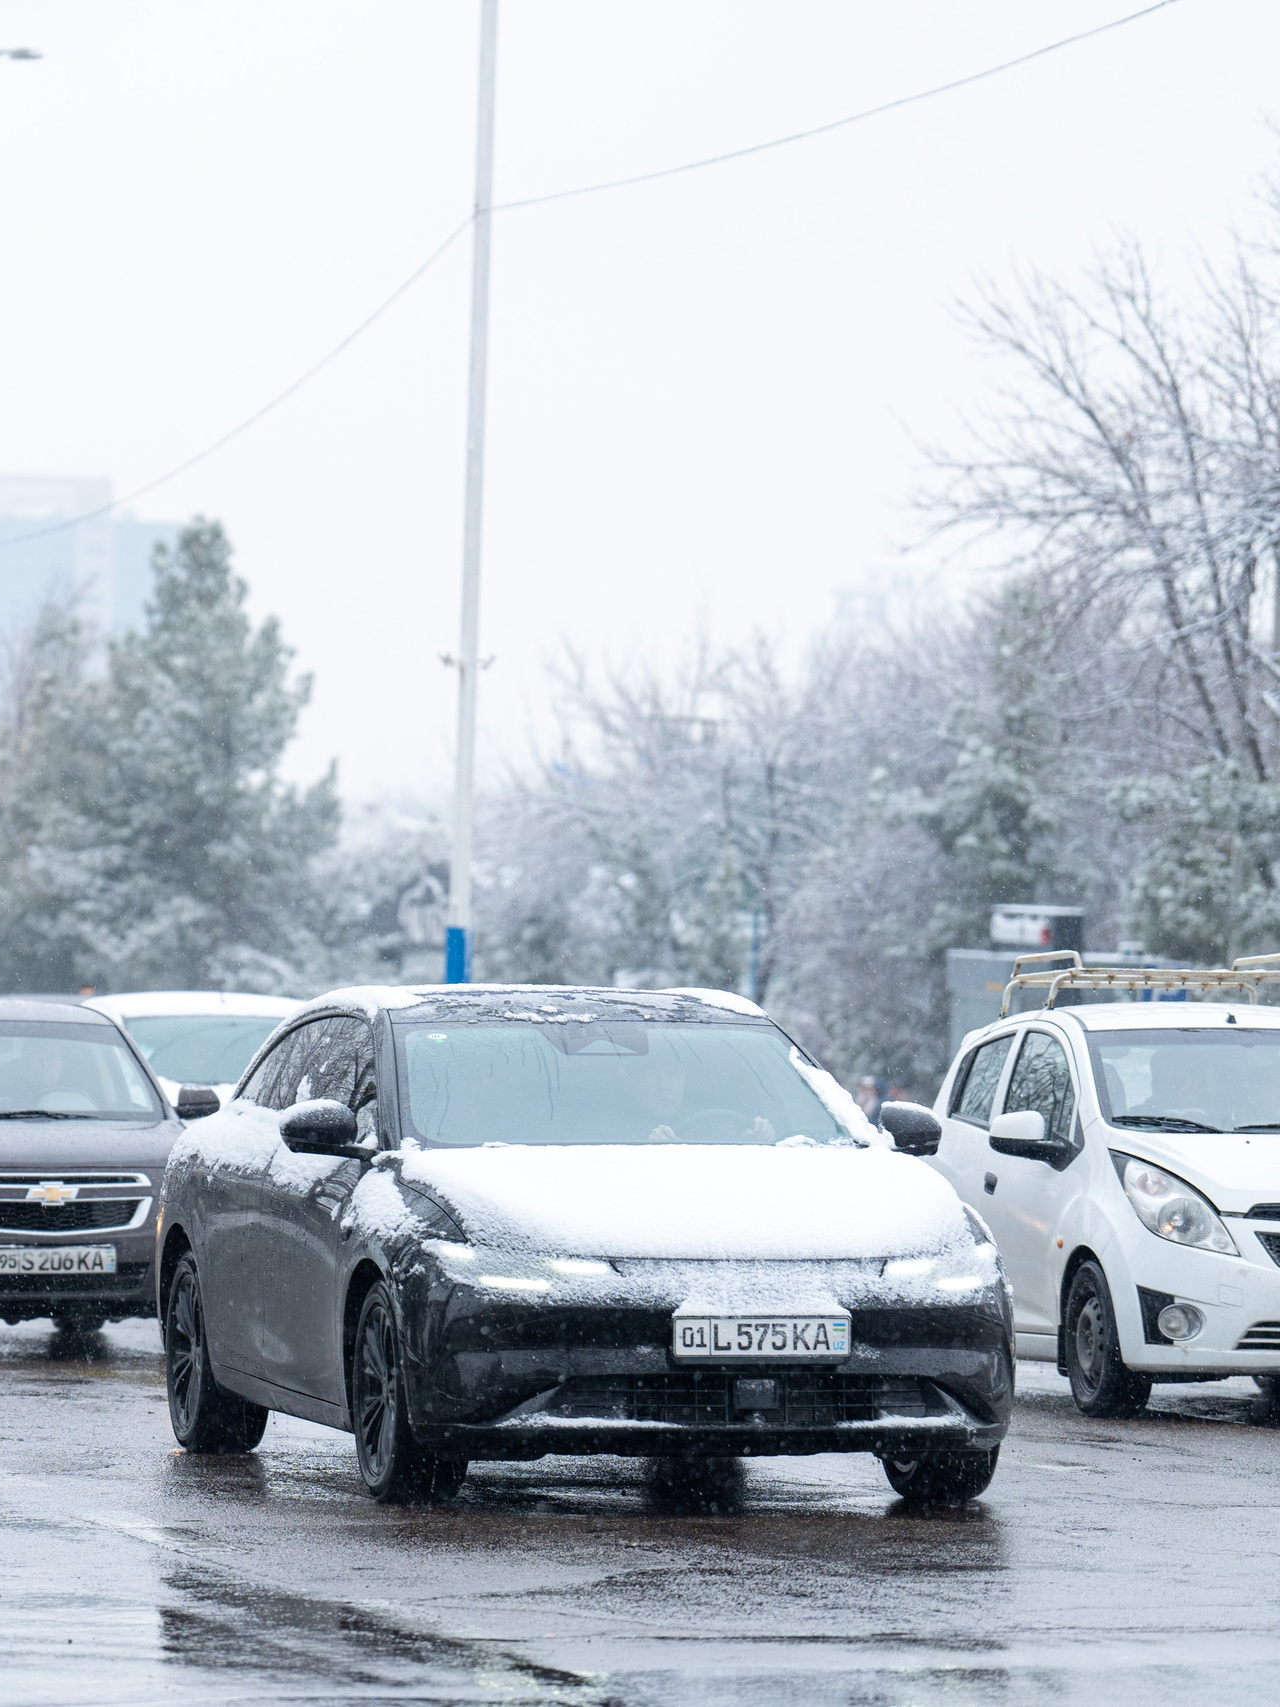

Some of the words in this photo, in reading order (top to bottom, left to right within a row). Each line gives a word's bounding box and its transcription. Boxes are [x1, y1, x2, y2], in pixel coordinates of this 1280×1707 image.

[0, 1254, 18, 1269] 95
[682, 1326, 707, 1348] 01
[832, 1340, 846, 1350] UZ
